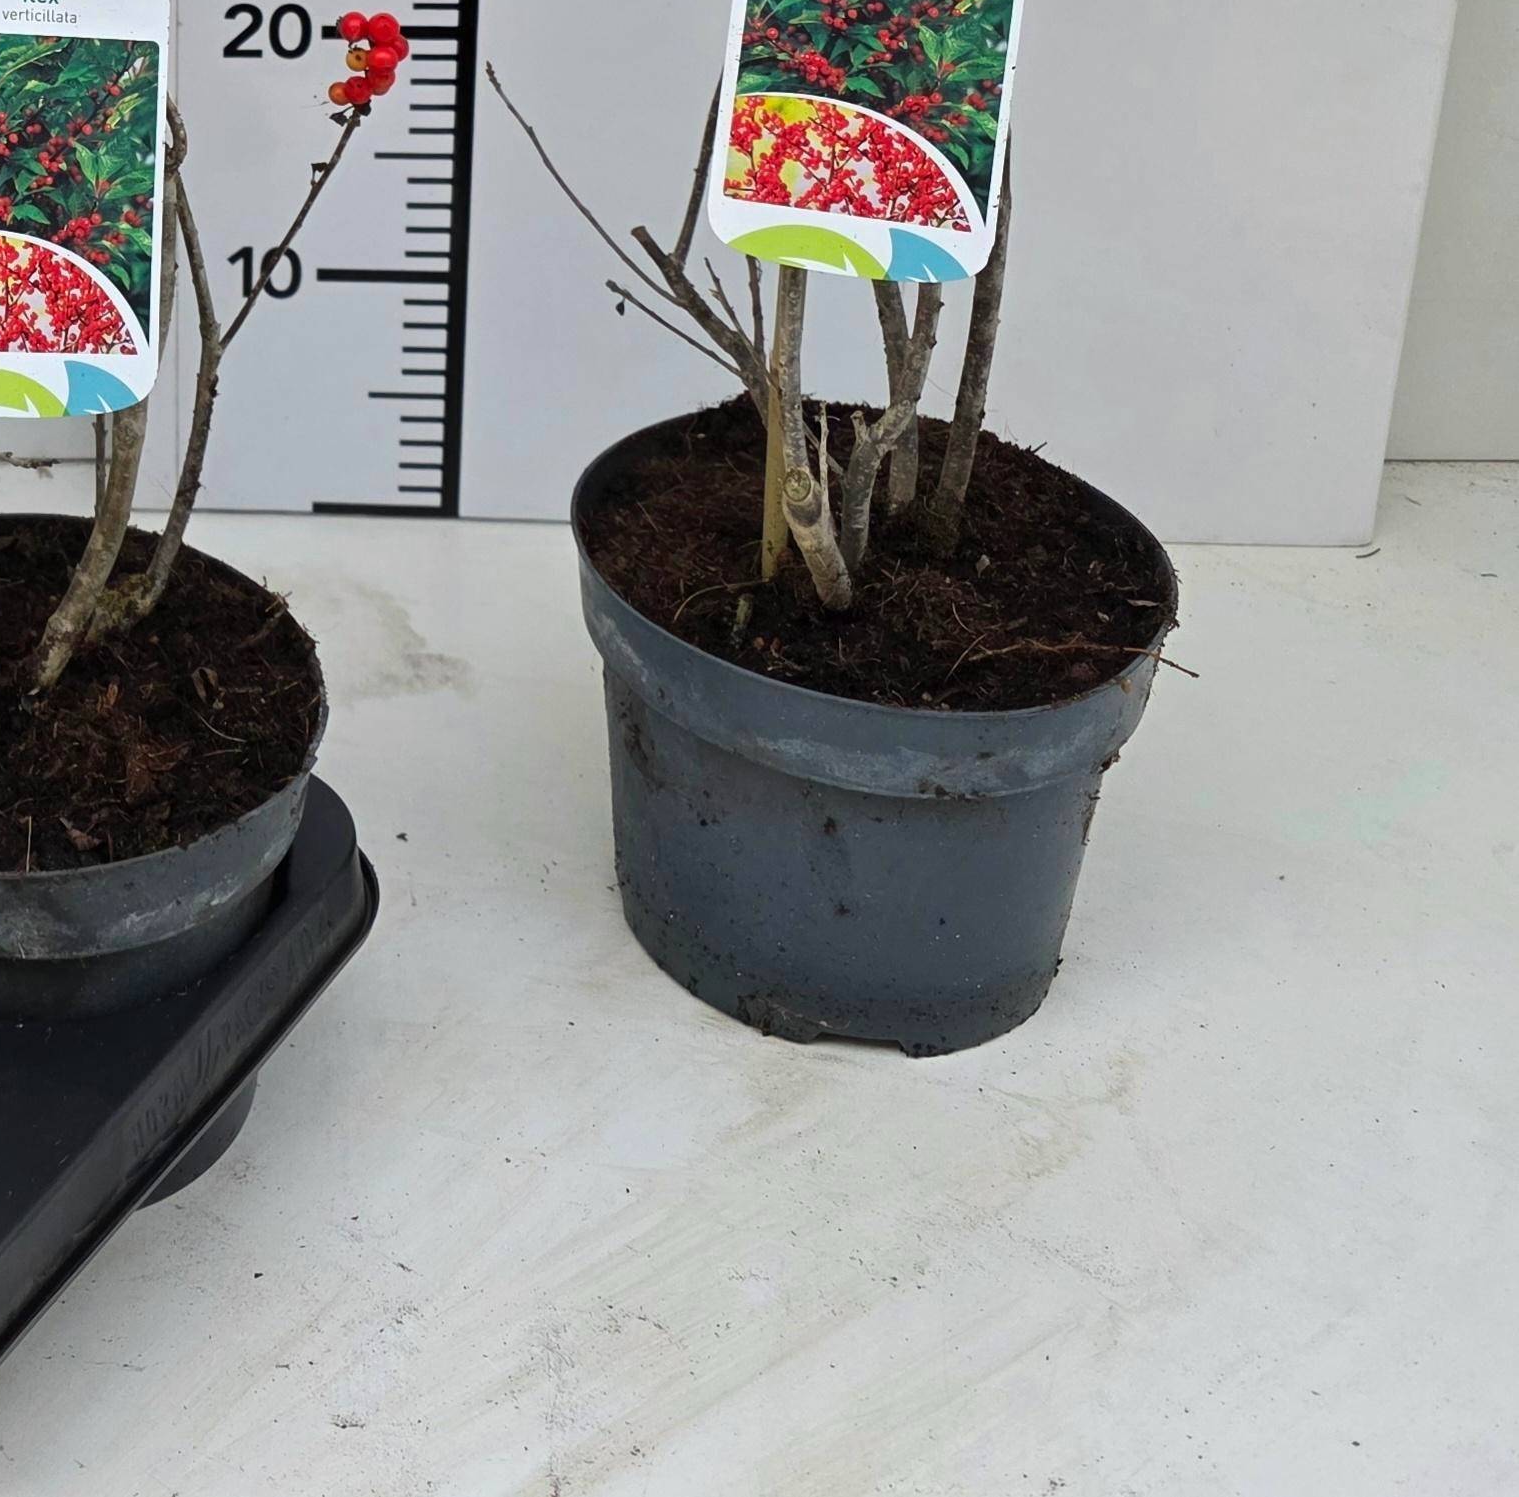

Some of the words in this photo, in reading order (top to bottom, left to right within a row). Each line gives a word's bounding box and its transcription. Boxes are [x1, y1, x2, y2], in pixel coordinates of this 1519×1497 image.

[2, 8, 78, 24] verticillata
[222, 3, 313, 60] 20
[227, 246, 303, 300] 10
